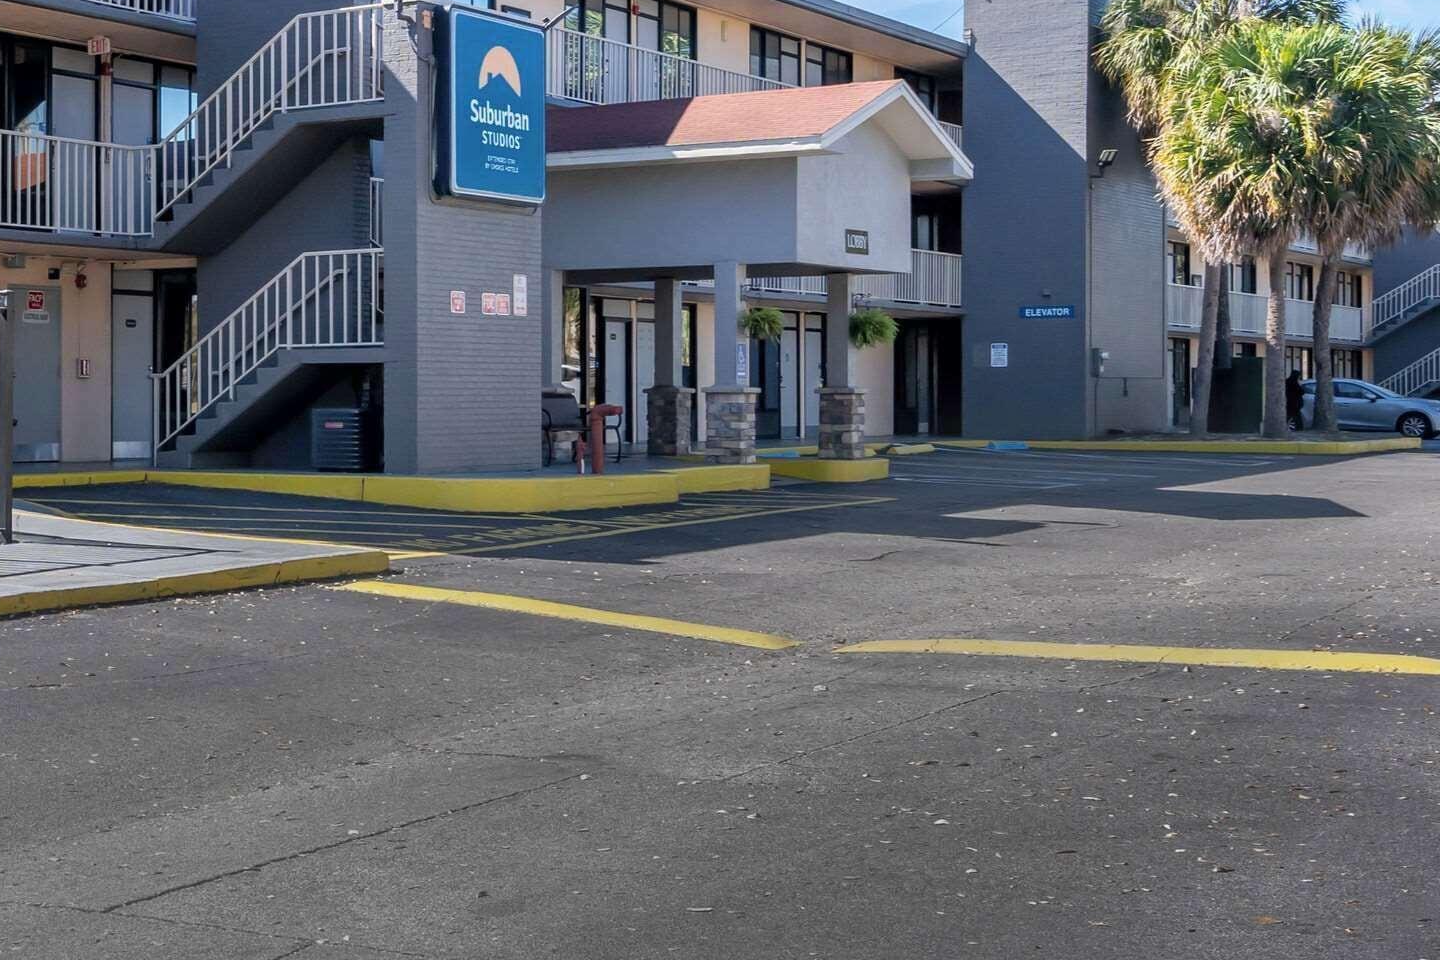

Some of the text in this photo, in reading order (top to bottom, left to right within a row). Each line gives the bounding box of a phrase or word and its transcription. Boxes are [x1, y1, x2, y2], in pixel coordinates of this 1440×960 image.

[470, 98, 530, 132] Suburban
[481, 129, 521, 150] STUDIOS
[1025, 307, 1070, 317] ELEVATOR
